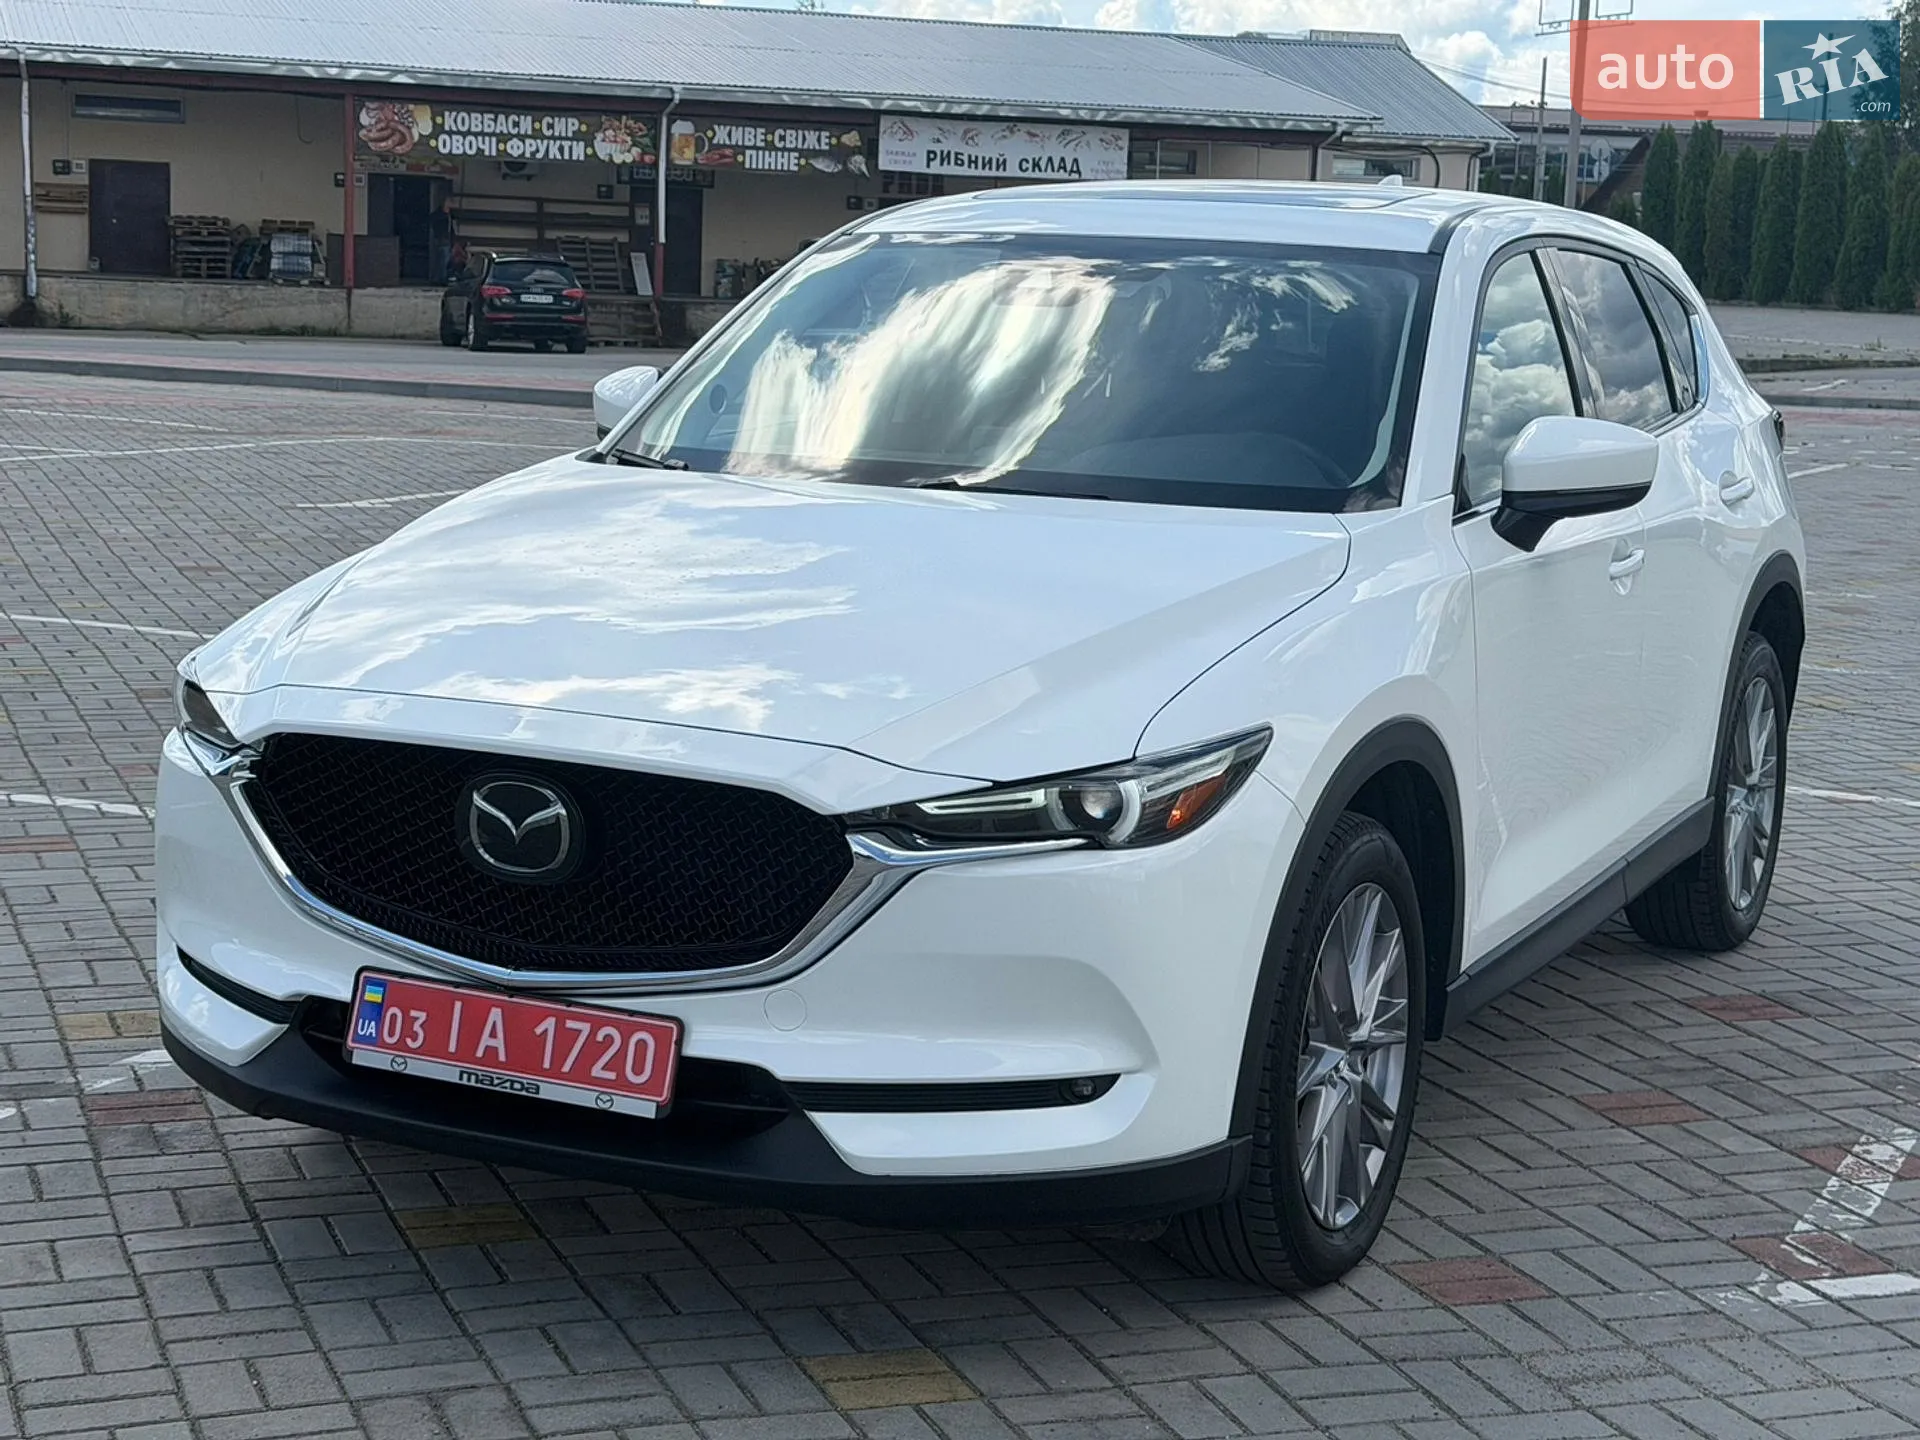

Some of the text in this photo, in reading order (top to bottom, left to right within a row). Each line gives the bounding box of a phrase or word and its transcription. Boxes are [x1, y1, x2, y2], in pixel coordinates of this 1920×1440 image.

[444, 111, 580, 137] КОВБАСИ СИР
[712, 124, 830, 150] ЖИВЕ СВІЖЕ
[438, 134, 585, 160] ОВОЧІ ФРУКТИ
[744, 150, 799, 171] ПІННЕ
[926, 149, 1082, 178] РИБНИЙ СКЛАД
[357, 1018, 376, 1038] UA
[382, 1000, 655, 1085] 03 IA 1720
